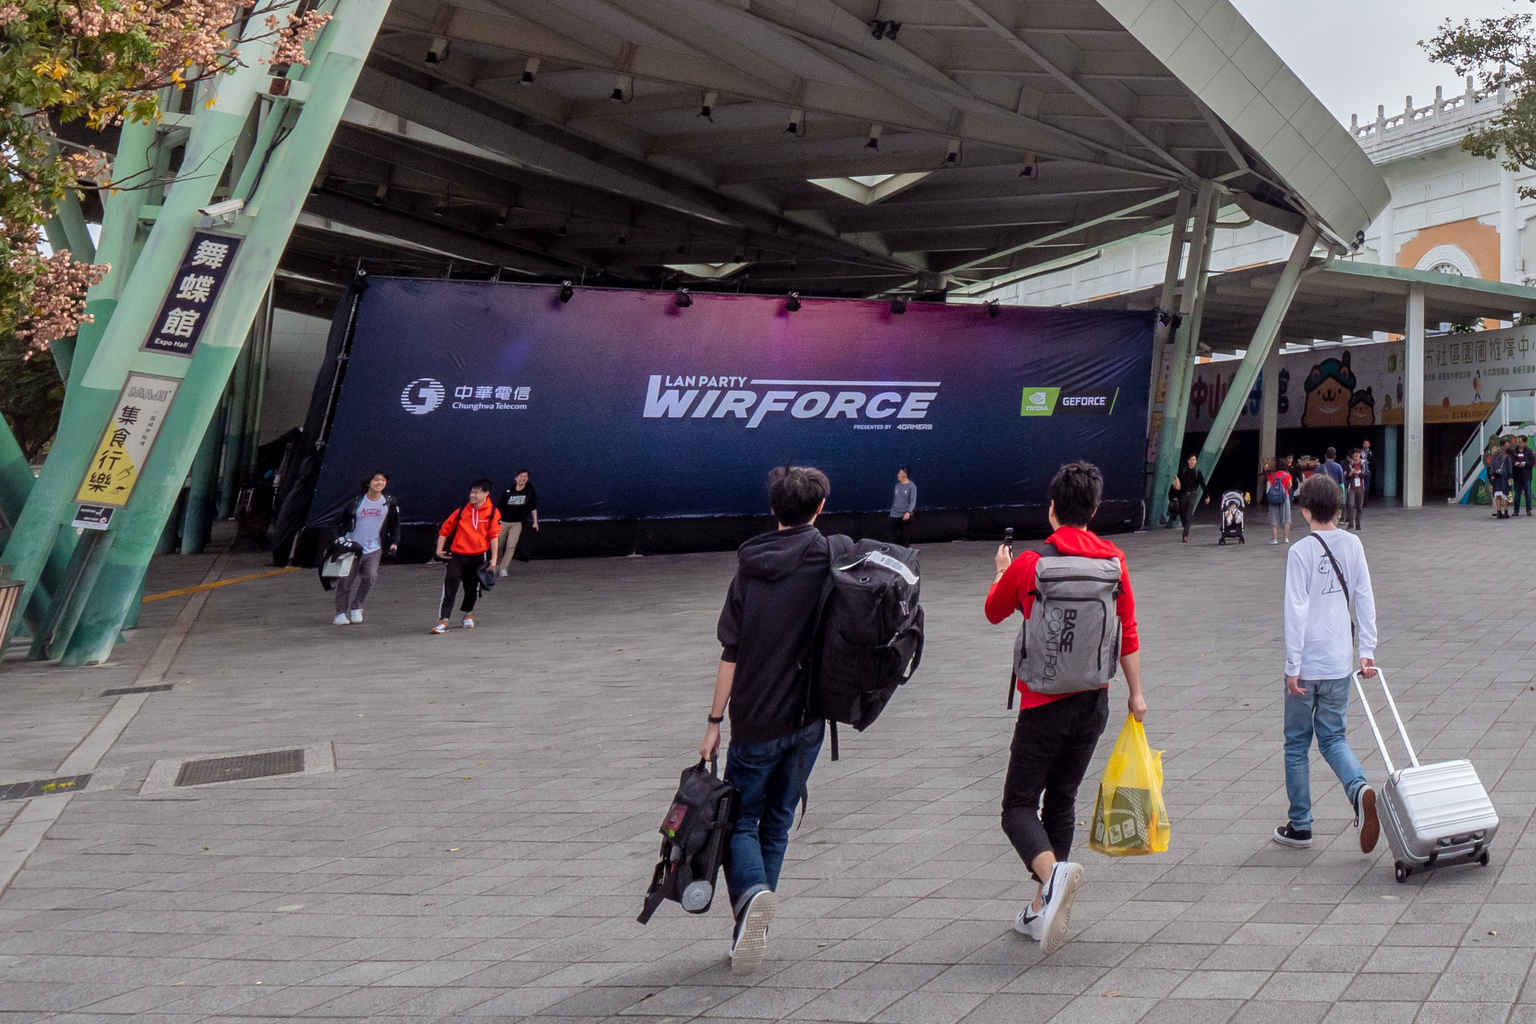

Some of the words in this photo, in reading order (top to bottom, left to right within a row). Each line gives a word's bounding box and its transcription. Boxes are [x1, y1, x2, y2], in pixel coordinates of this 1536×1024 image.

[160, 239, 229, 338] 舞蝶館
[154, 337, 173, 348] Expo
[174, 339, 189, 349] Hall
[454, 384, 532, 401] 中華電信
[665, 375, 695, 387] LAN
[698, 376, 748, 388] PARTY
[452, 401, 494, 412] Chunghwa
[495, 401, 528, 410] Telecom
[643, 374, 938, 429] WIRFORCE
[1062, 396, 1105, 406] GEFORCE
[88, 405, 141, 493] 集食行樂
[1042, 607, 1063, 687] CONTROL
[1060, 609, 1078, 654] BASE
